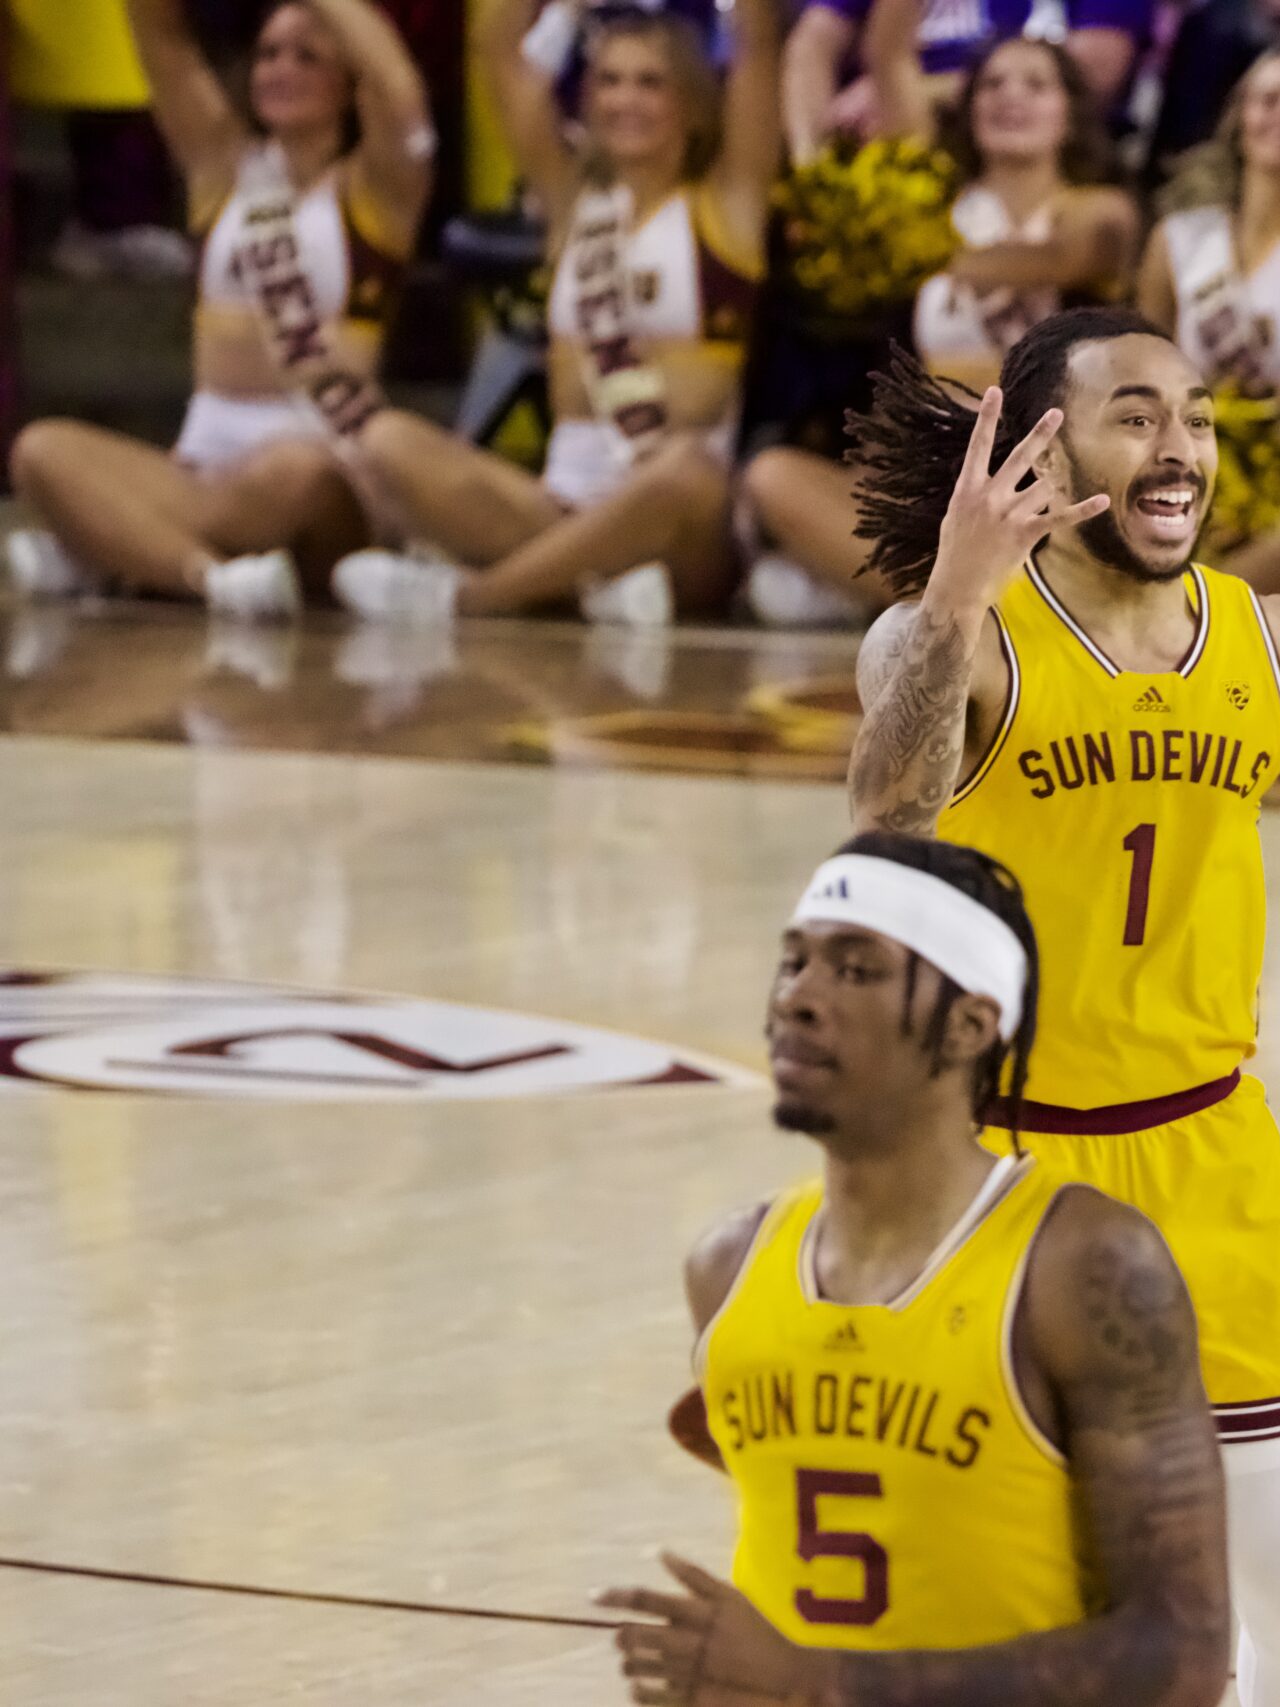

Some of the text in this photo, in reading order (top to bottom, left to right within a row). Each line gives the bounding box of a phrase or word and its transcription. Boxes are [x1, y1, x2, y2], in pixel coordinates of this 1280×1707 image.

[1018, 730, 1271, 799] SUN DEVILS
[1122, 823, 1156, 946] 1
[722, 1371, 992, 1469] SUN DEVILS
[793, 1466, 890, 1627] 5
